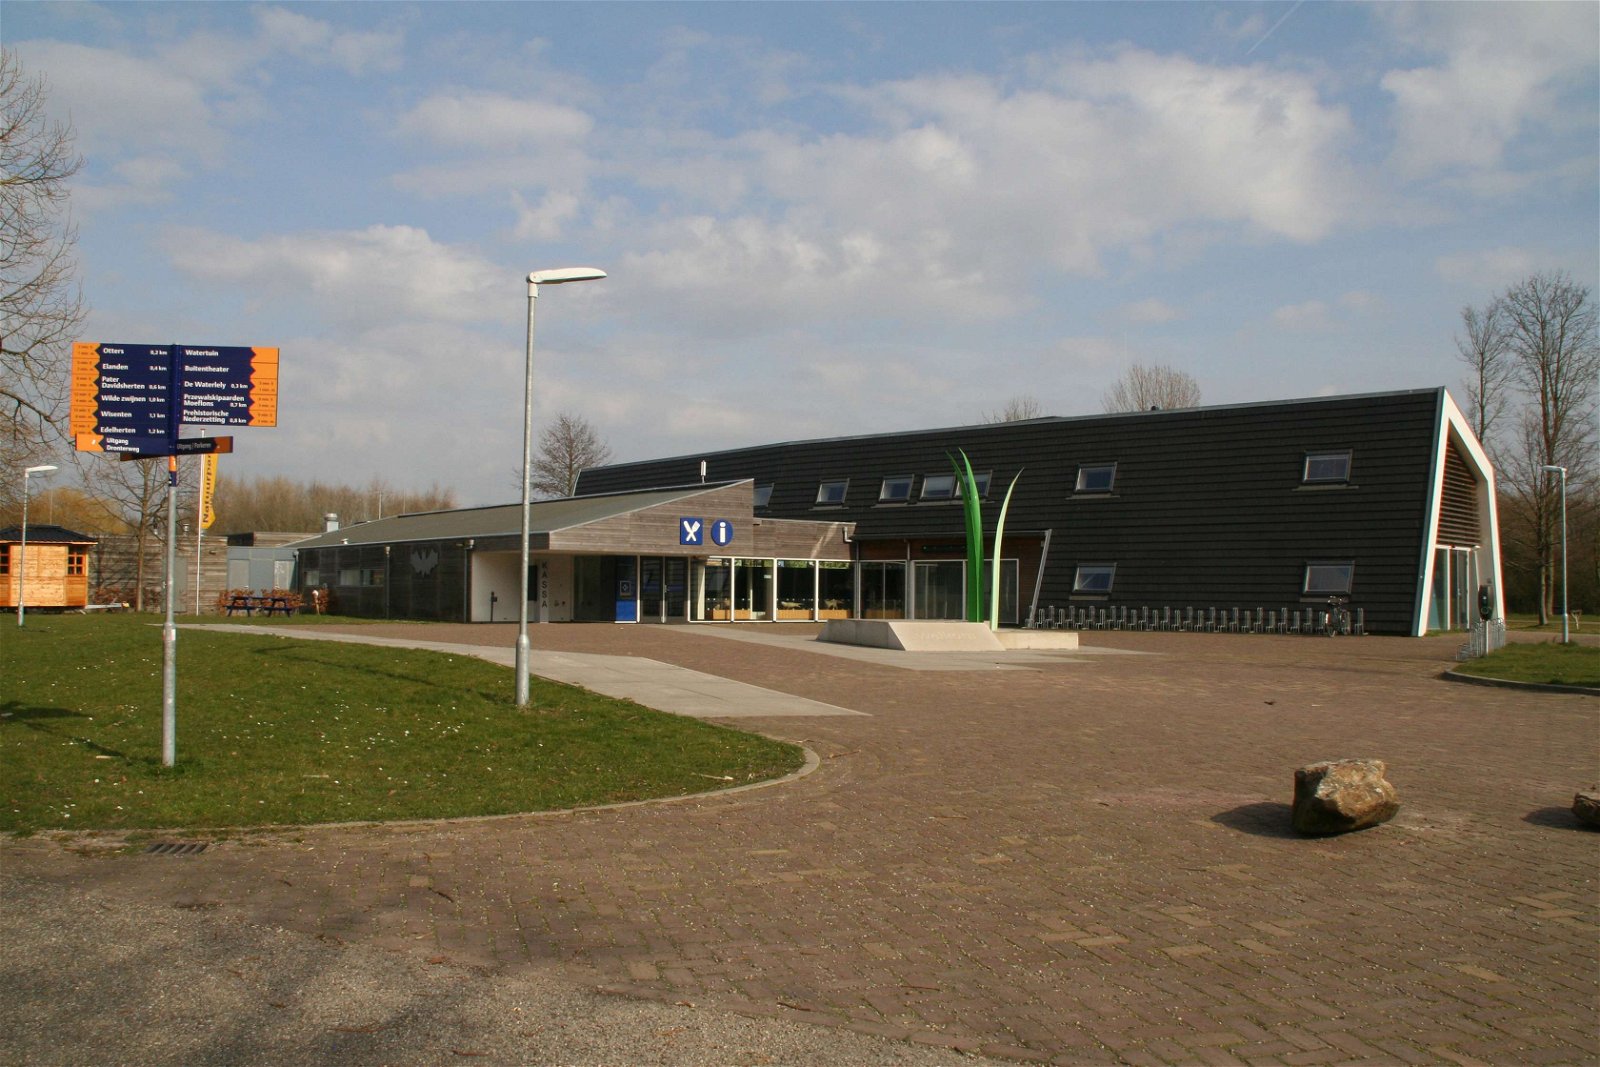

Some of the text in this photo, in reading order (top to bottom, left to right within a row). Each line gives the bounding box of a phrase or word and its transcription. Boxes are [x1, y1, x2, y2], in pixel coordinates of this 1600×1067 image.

[183, 394, 245, 402] Przewalskipaarden
[183, 416, 226, 424] Nederzetting
[106, 437, 129, 445] Uitgang
[106, 445, 139, 453] Dronterweg
[203, 455, 212, 523] Natuurpar
